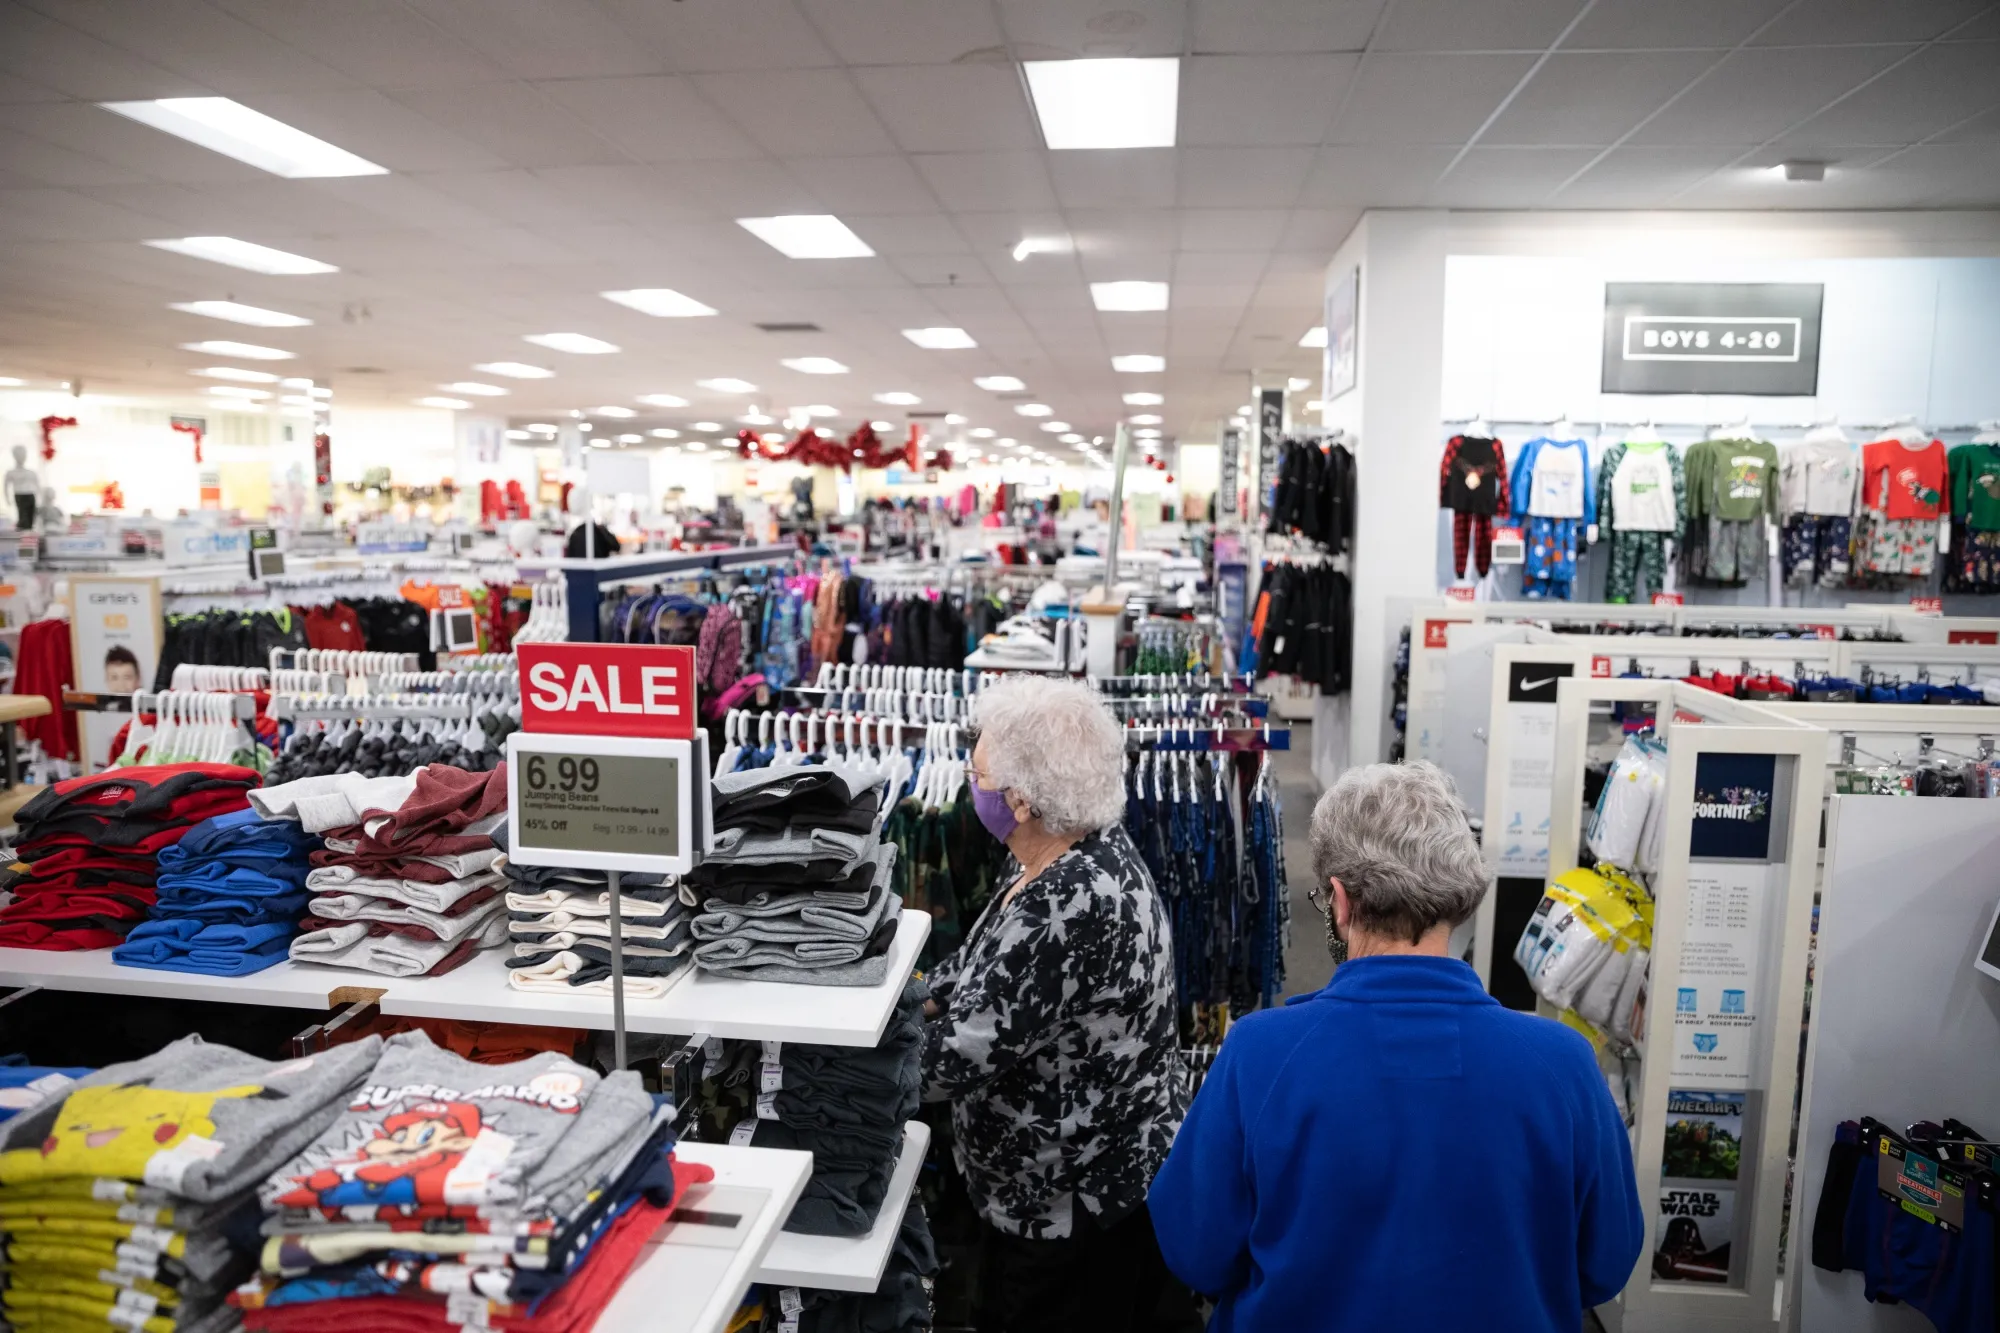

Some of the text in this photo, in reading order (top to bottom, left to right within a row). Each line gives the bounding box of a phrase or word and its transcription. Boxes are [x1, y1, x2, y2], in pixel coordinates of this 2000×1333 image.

[1644, 330, 1781, 349] BOYS 4-20
[89, 592, 139, 605] carter's
[528, 662, 680, 715] SALE
[526, 755, 599, 792] 6.99
[524, 789, 599, 802] Jumping Beans
[524, 818, 568, 831] 45% Off
[616, 824, 638, 834] 12.99
[646, 826, 670, 836] 14.99
[350, 1084, 580, 1113] SUPER MARIO
[1899, 1175, 1941, 1199] BREATHABLE
[1660, 1191, 1720, 1205] STAR
[1660, 1203, 1720, 1217] WARS
